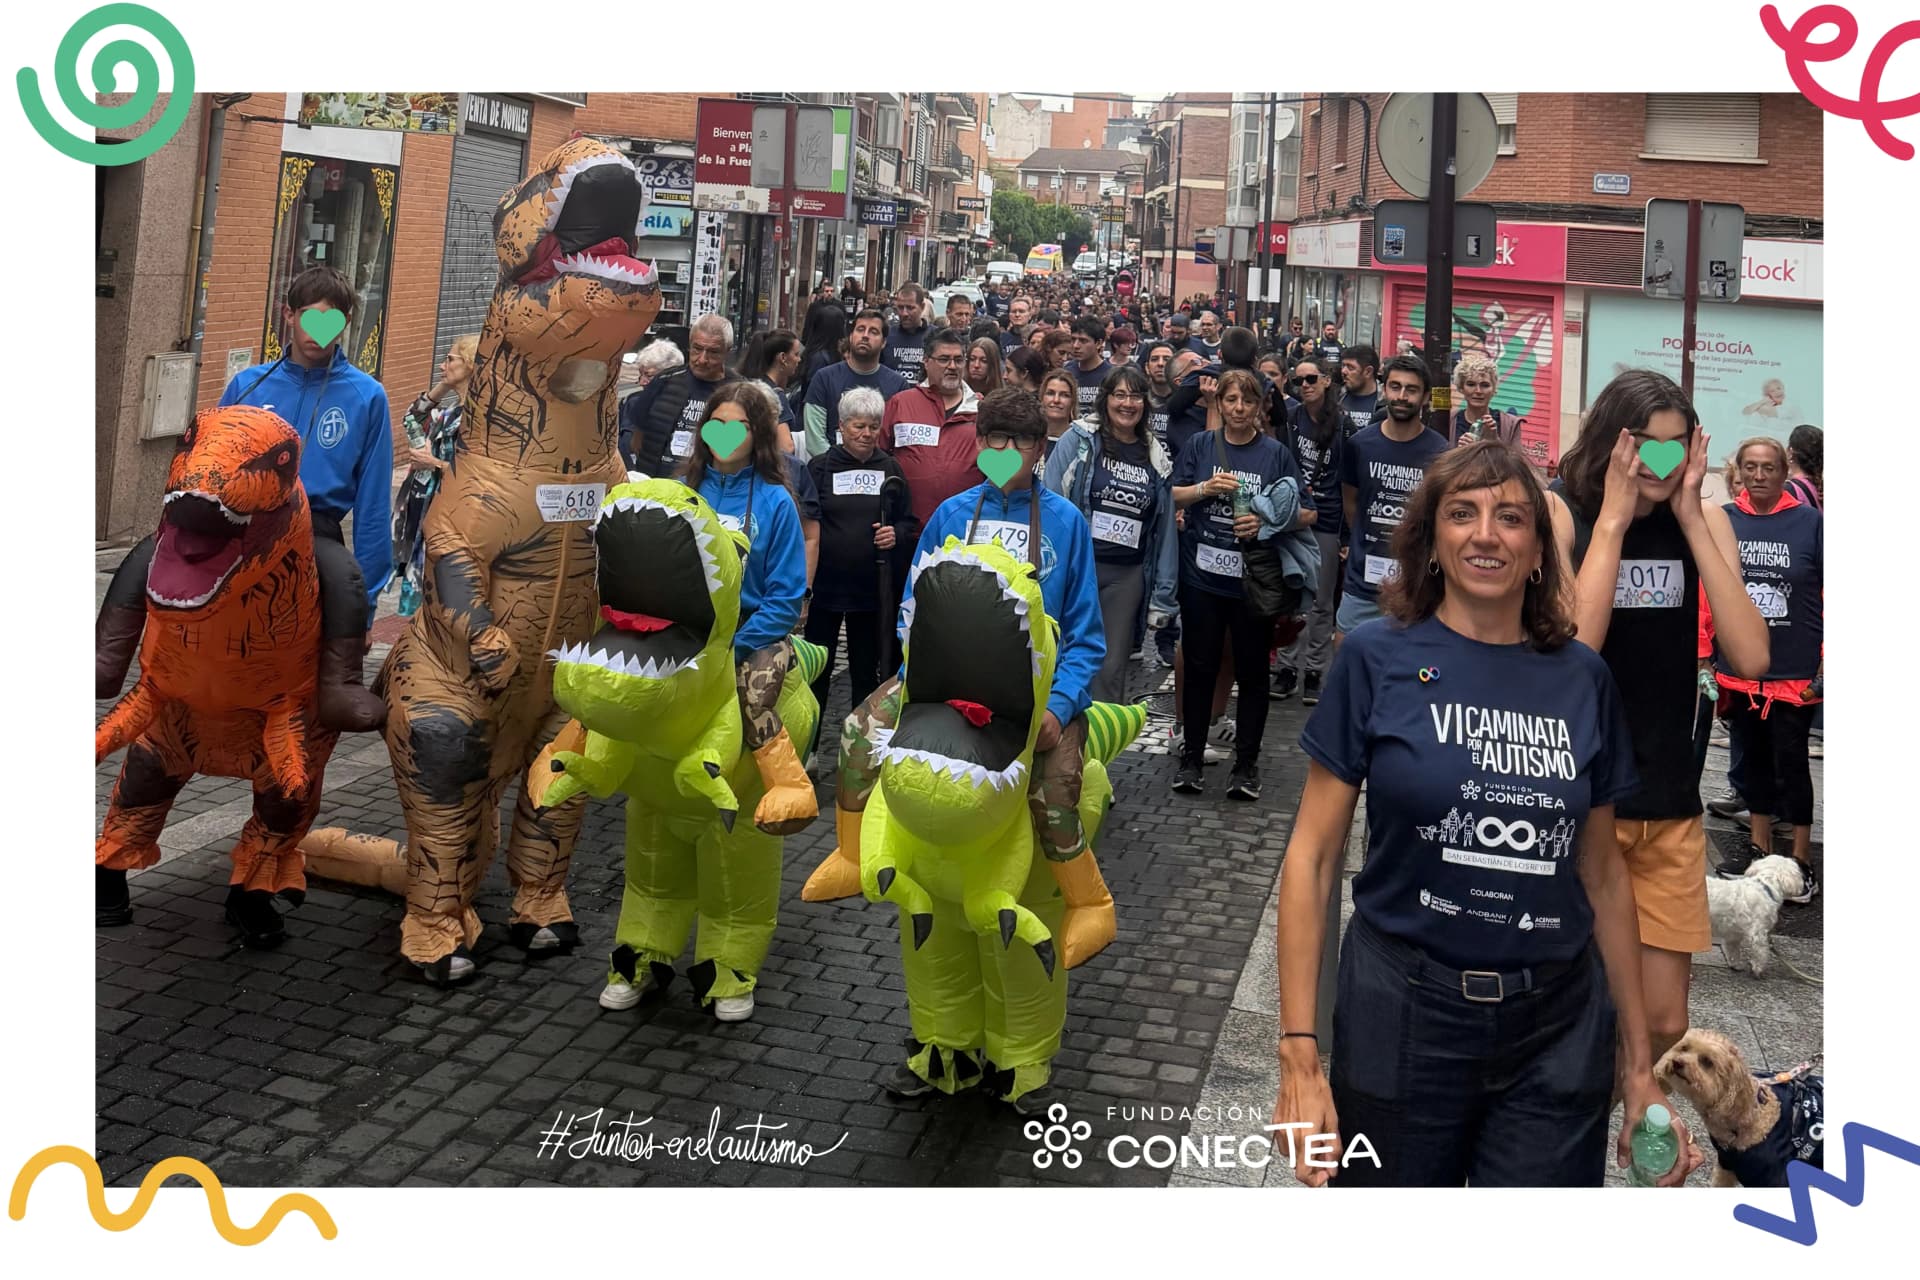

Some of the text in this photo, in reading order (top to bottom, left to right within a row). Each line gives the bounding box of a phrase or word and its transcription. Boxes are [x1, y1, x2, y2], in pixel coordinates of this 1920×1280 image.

[489, 99, 500, 128] DE
[500, 102, 529, 133] MOVILES
[730, 144, 736, 152] a
[699, 154, 712, 164] de
[715, 155, 726, 165] la
[864, 204, 893, 214] BAZAR
[862, 213, 894, 222] OUTLET
[1662, 337, 1754, 355] POOLOGÍA
[910, 426, 932, 437] 688
[1110, 459, 1147, 477] CAMINATA
[1369, 461, 1382, 479] VI
[1381, 463, 1424, 481] CAMINATA
[854, 474, 877, 486] 603
[1230, 470, 1262, 485] AMINATA
[566, 490, 595, 507] 618
[1112, 520, 1135, 536] 674
[992, 527, 1028, 547] 479
[1741, 541, 1790, 556] CAMINATA
[1215, 553, 1239, 567] 609
[1746, 552, 1791, 568] AUTISMO
[1630, 565, 1671, 589] 017
[1430, 703, 1571, 750] VI CAMINATA
[1467, 739, 1482, 752] POR
[1472, 741, 1577, 781] EL AUTISMO
[1484, 791, 1566, 810] CONECTEA
[1446, 852, 1463, 861] SAN
[1503, 860, 1513, 868] DE
[1470, 888, 1514, 902] COLABORAN
[1466, 908, 1507, 920] ANDBANK
